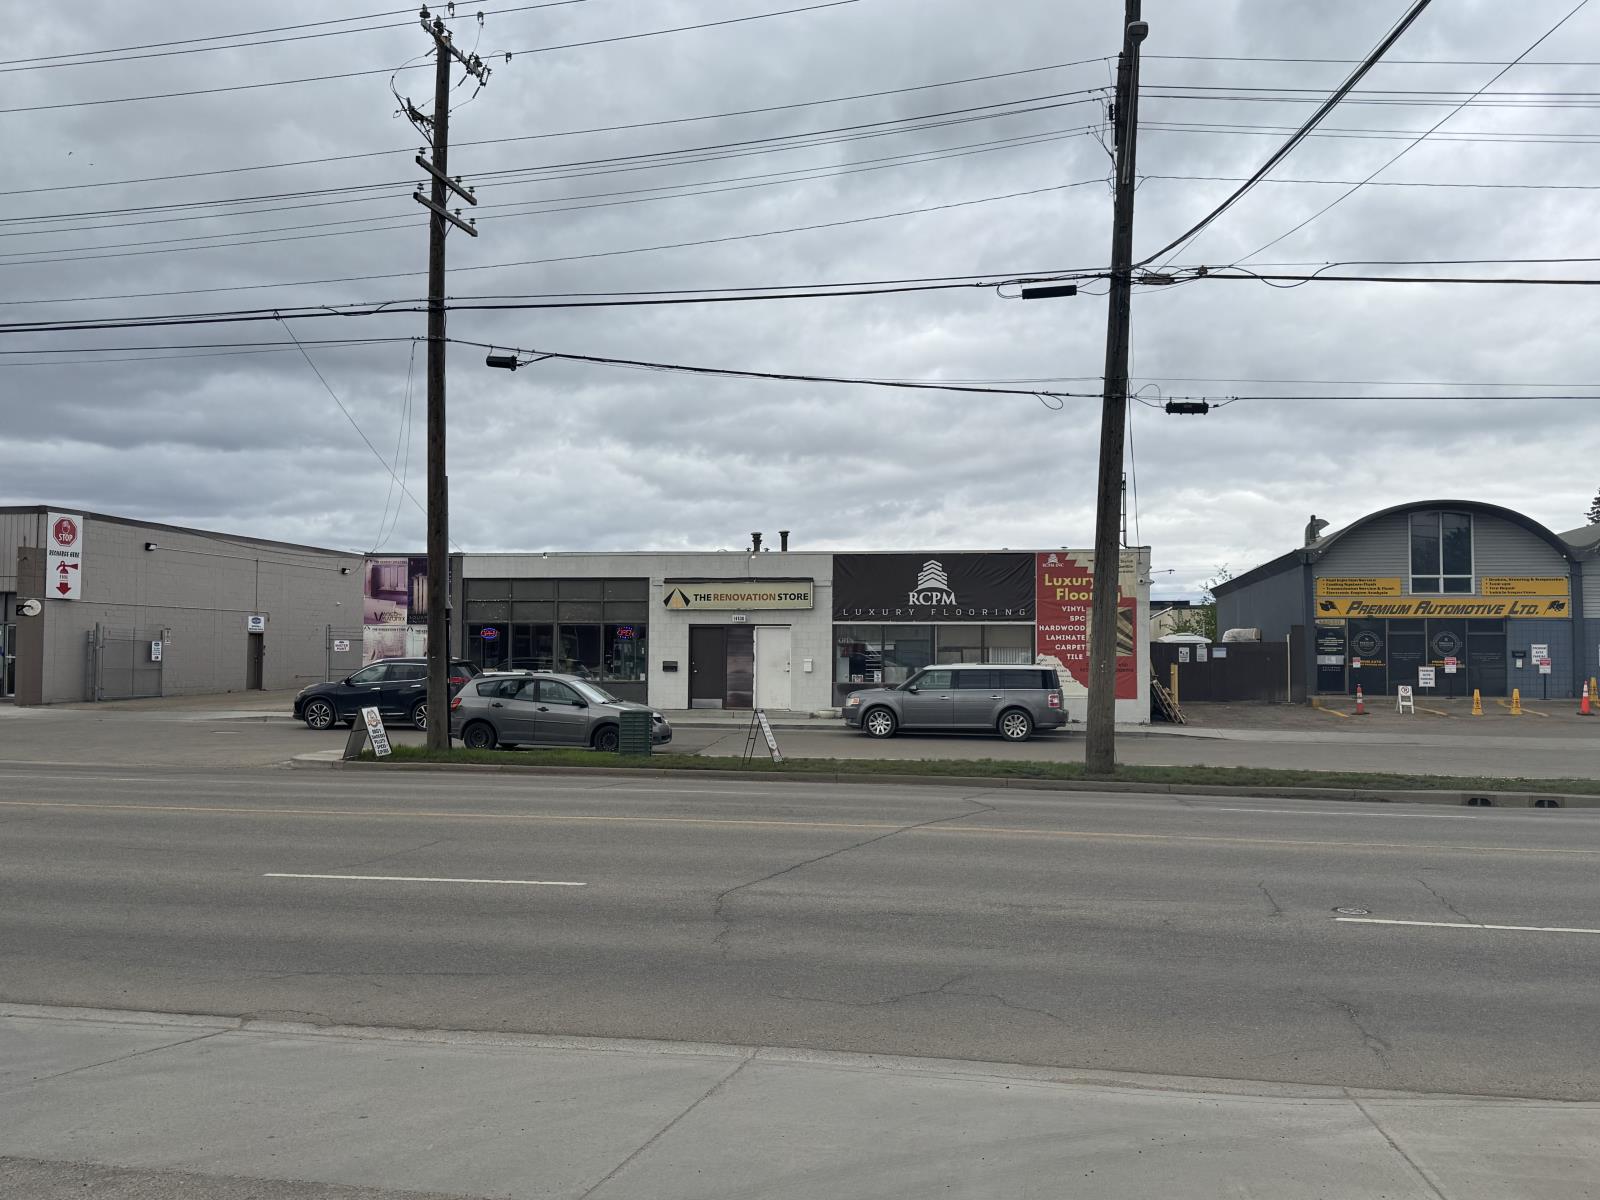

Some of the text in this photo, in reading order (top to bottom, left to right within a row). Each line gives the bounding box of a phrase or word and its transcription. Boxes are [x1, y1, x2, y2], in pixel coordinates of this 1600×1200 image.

[59, 533, 73, 541] STOP
[694, 592, 809, 601] THE RENOVATION STORE
[908, 591, 957, 605] RCPM
[1346, 600, 1539, 614] PREMIUM AUTOMOTIVE LTD.
[843, 608, 1026, 616] LUXURY FLOORING
